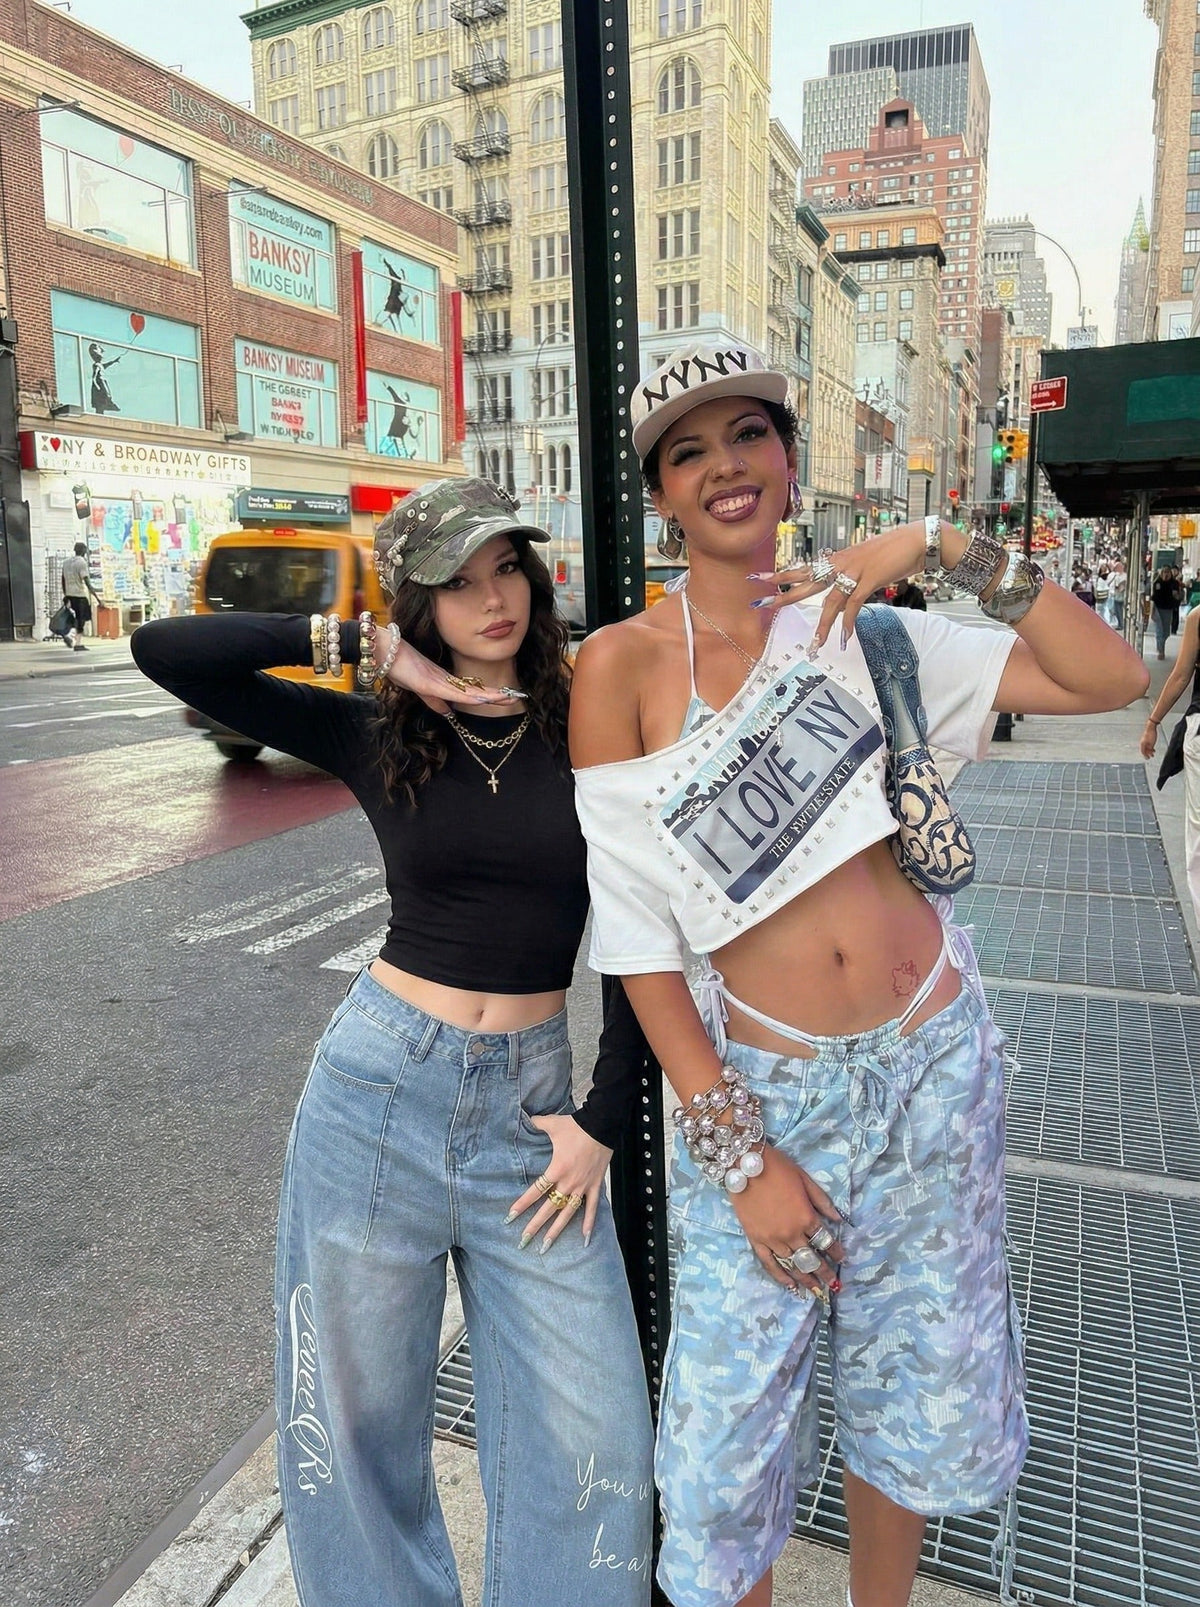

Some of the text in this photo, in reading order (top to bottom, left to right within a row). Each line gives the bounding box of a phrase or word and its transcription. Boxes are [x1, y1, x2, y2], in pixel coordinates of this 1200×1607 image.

[249, 230, 311, 278] BANKSY
[249, 265, 314, 301] MUSEUM
[243, 346, 325, 384] BANKSY MUSEUM
[259, 380, 278, 394] THE
[62, 438, 85, 456] NY
[94, 442, 106, 457] &
[114, 444, 201, 467] BROADWAY
[207, 455, 247, 471] GIFTS
[692, 832, 732, 875] I
[716, 745, 818, 851] LOVE
[794, 688, 860, 754] NY
[768, 832, 794, 859] THE
[576, 1452, 634, 1511] You
[588, 1522, 625, 1569] be
